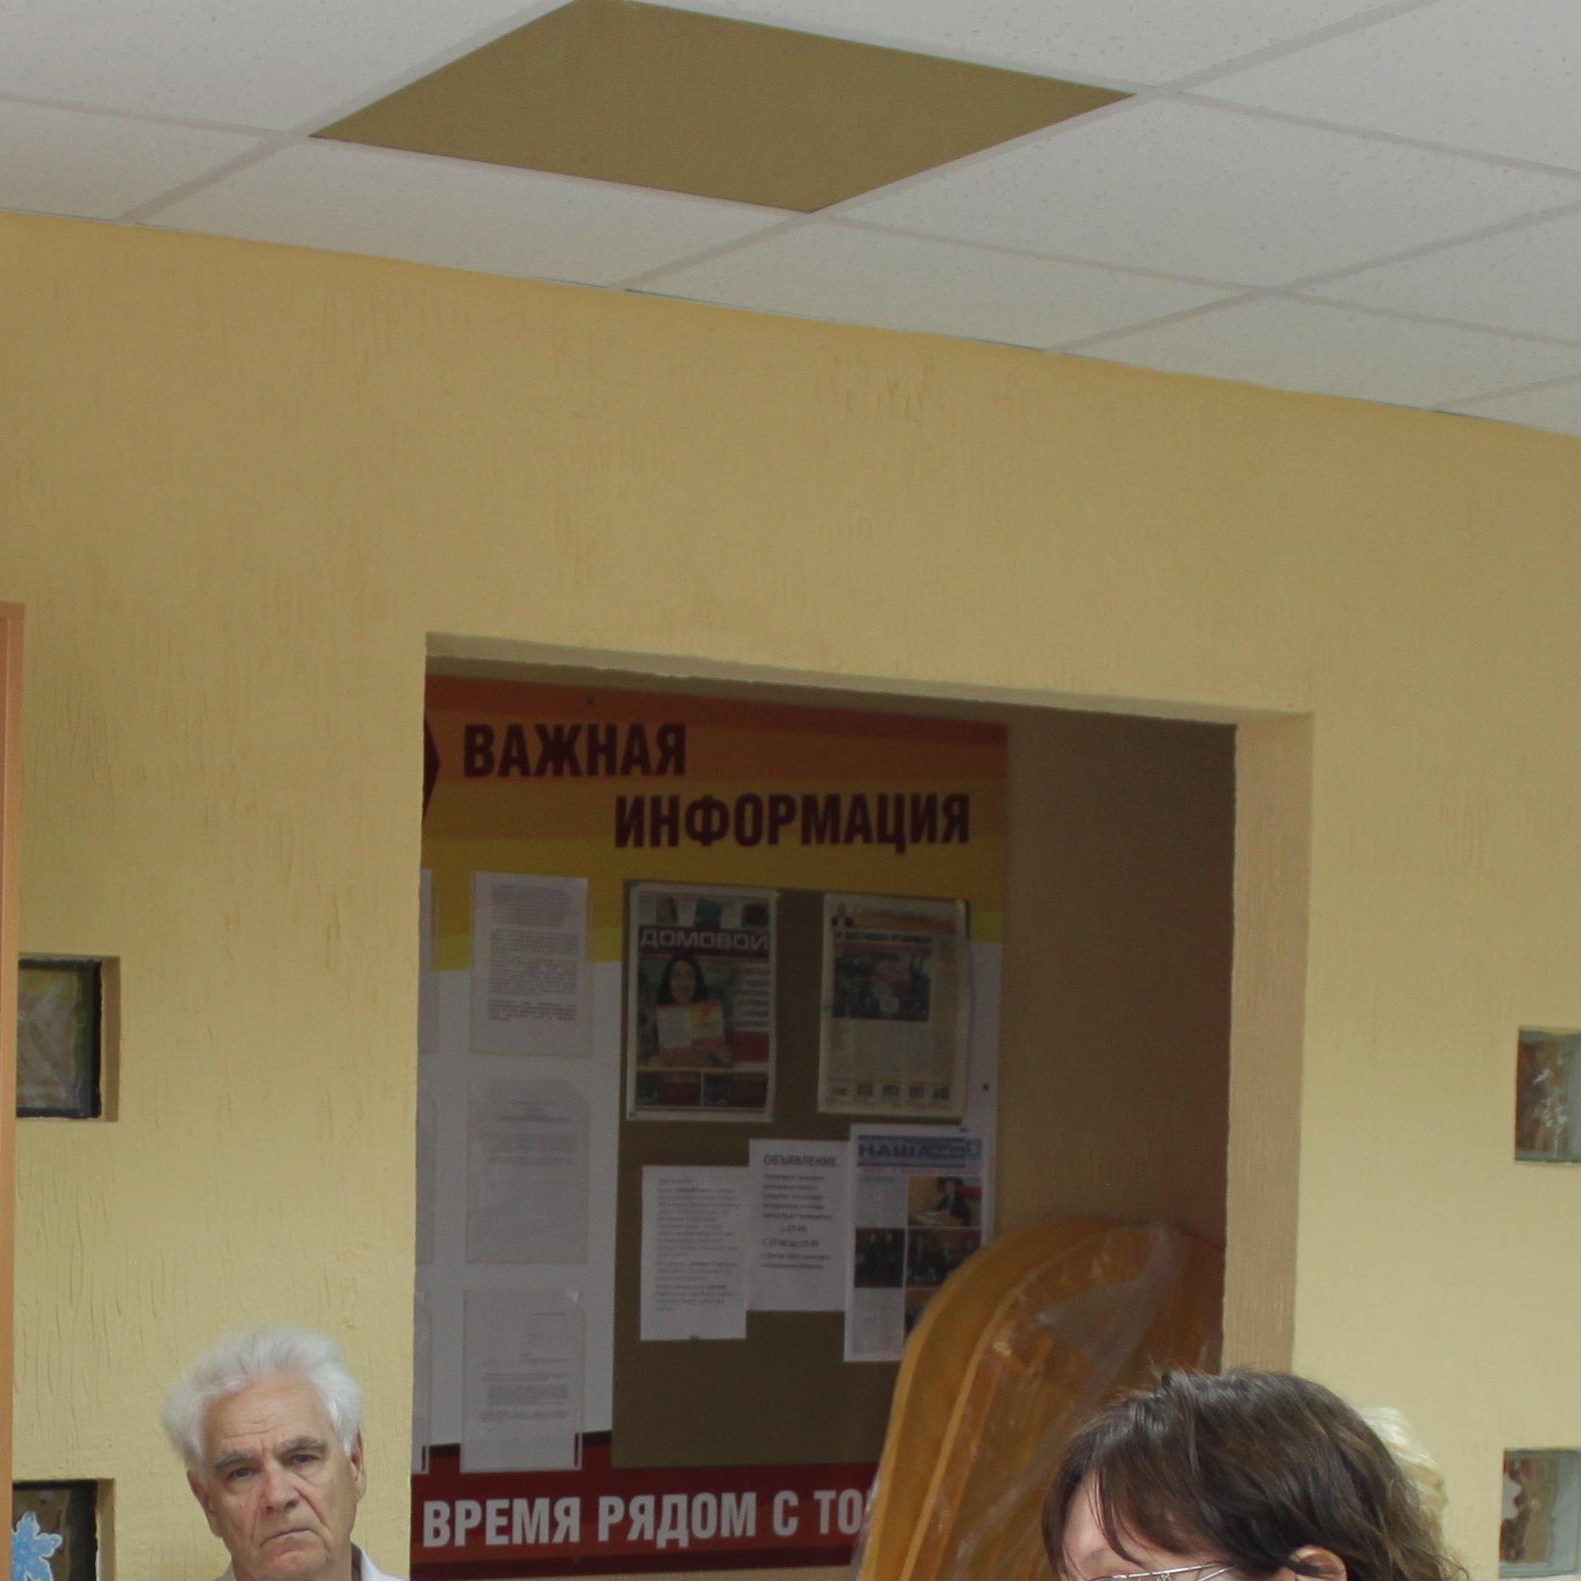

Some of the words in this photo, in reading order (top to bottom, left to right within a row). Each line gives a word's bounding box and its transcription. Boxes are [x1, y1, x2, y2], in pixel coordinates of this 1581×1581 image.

[464, 723, 686, 777] ВАЖНАЯ
[615, 794, 970, 854] ИНФОРМАЦИЯ
[640, 927, 769, 951] ДОМОВОЙ
[423, 1497, 581, 1549] ВРЕМЯ
[598, 1491, 757, 1549] РЯДОМ
[773, 1490, 799, 1536] С
